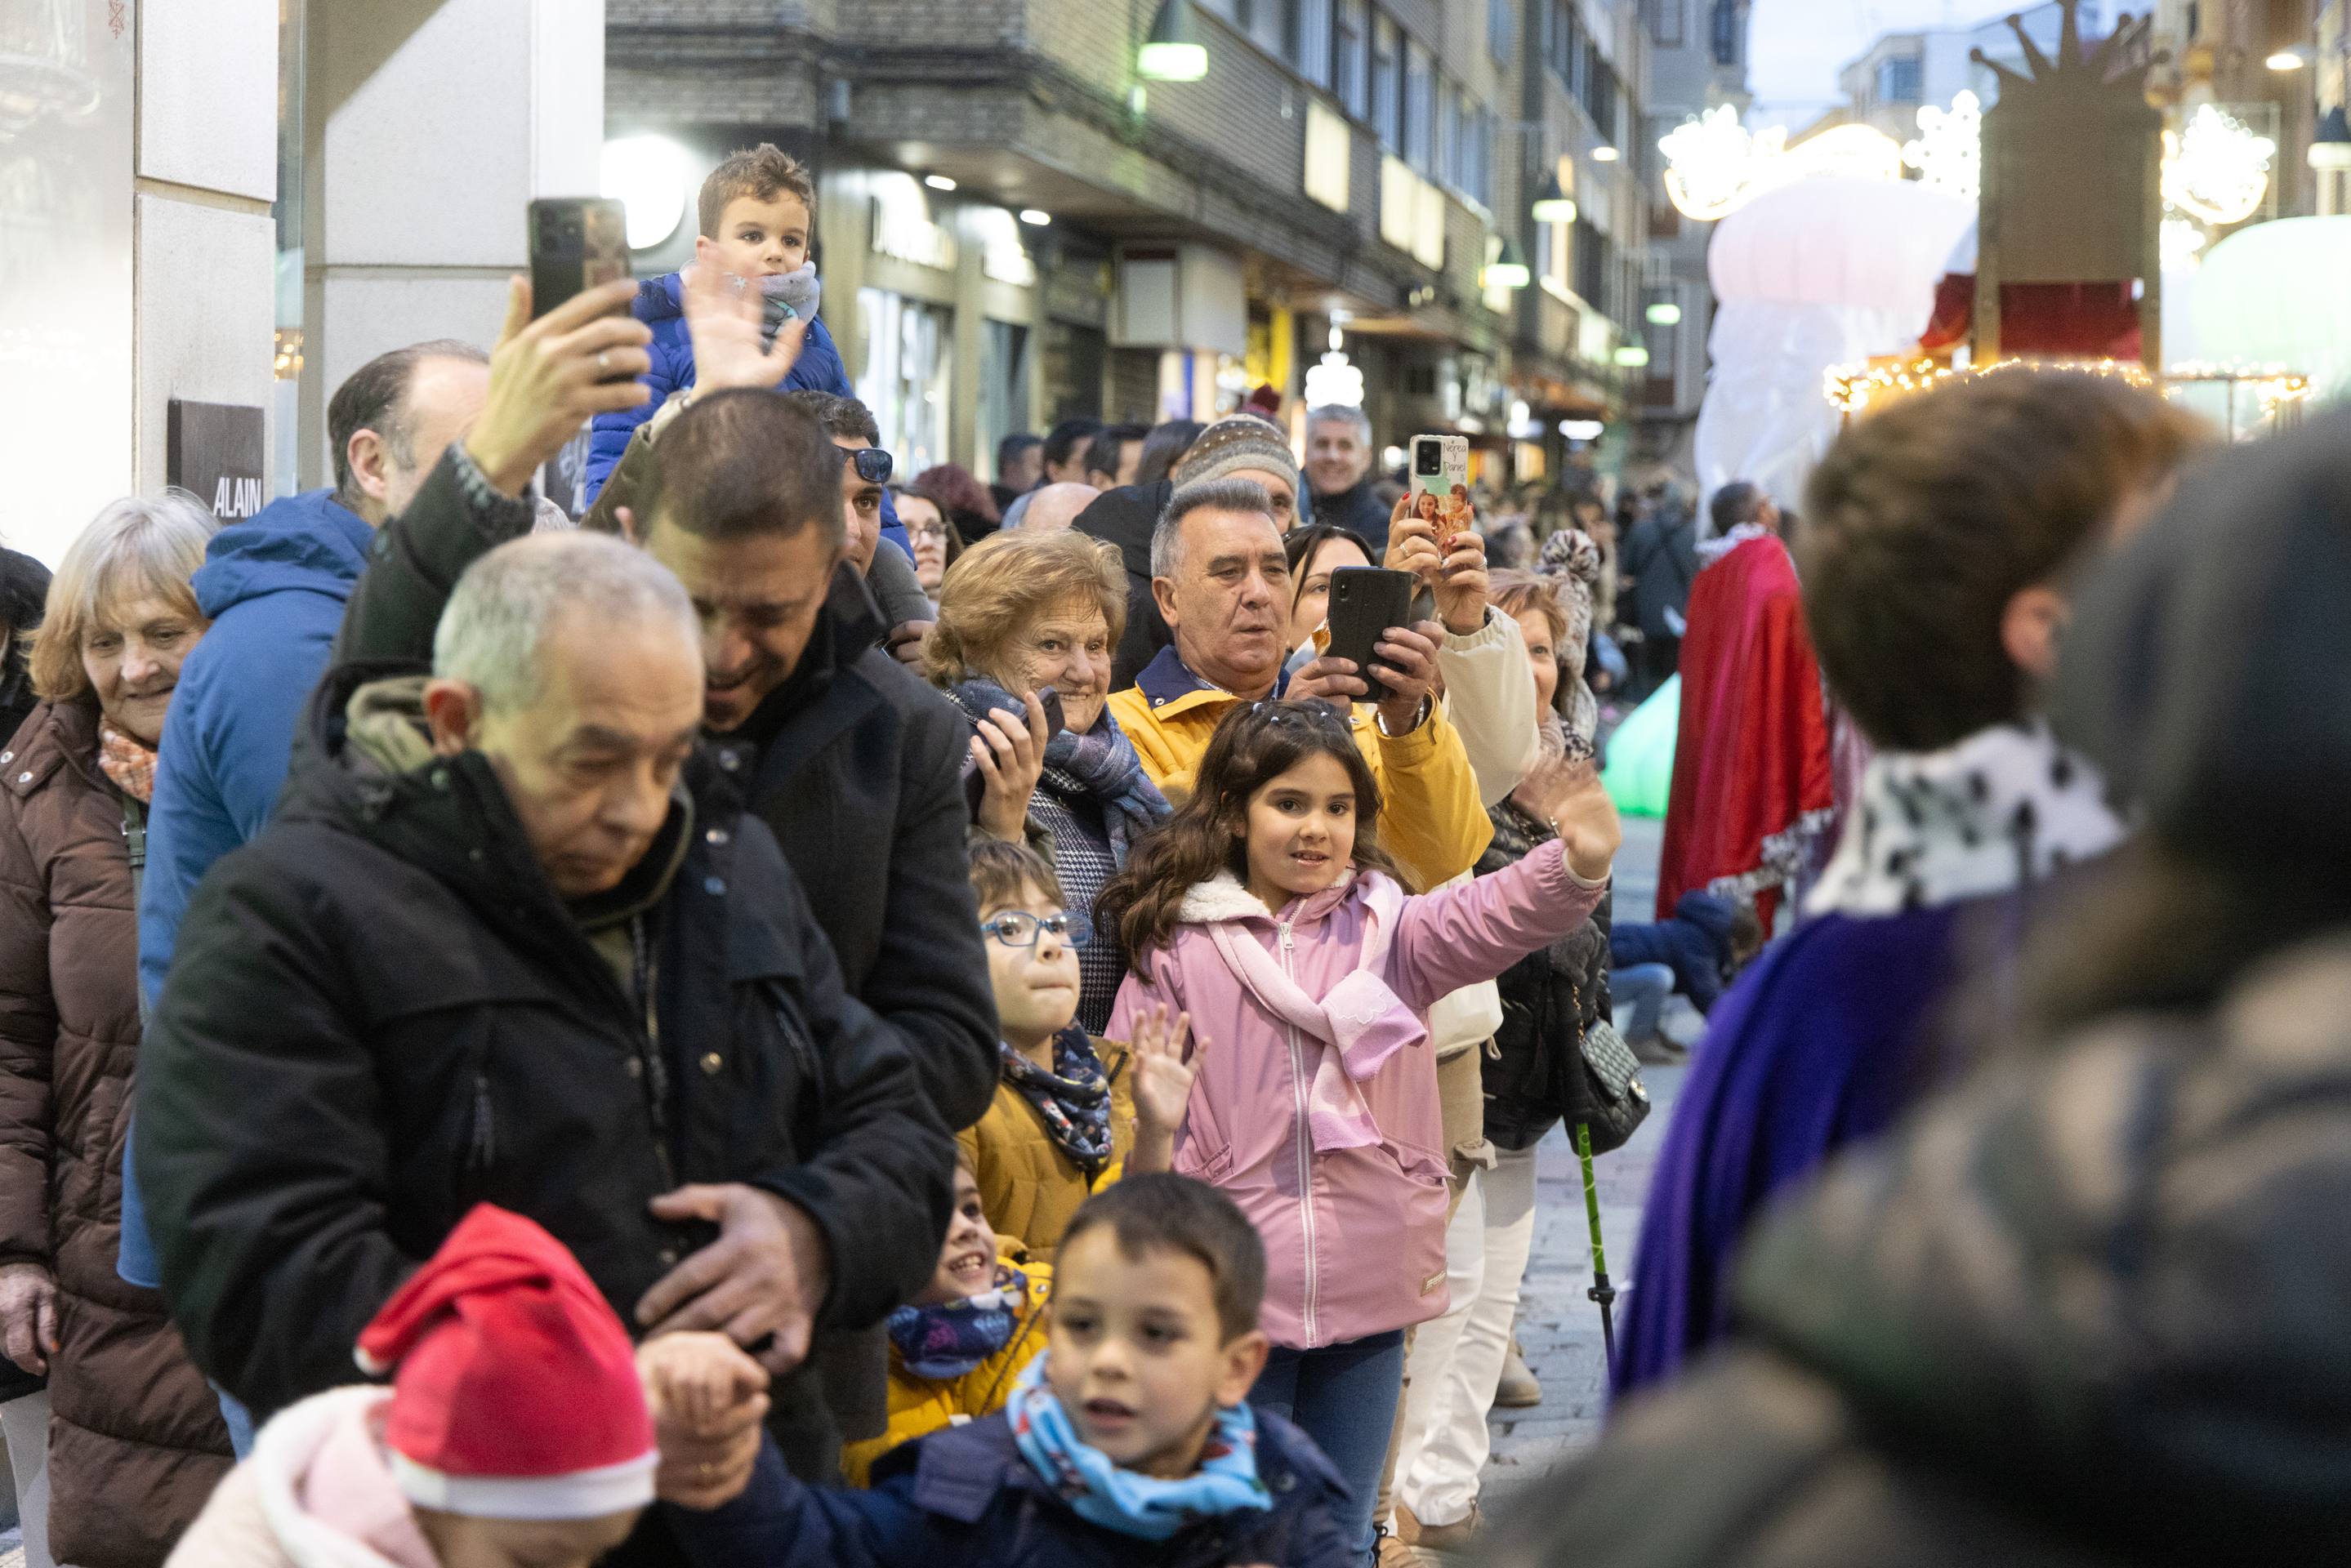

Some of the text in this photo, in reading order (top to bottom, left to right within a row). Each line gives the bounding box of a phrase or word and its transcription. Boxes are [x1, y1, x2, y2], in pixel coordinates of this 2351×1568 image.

[1443, 443, 1466, 453] Nerea
[1443, 461, 1466, 471] Daniel
[213, 477, 261, 517] ALAIN
